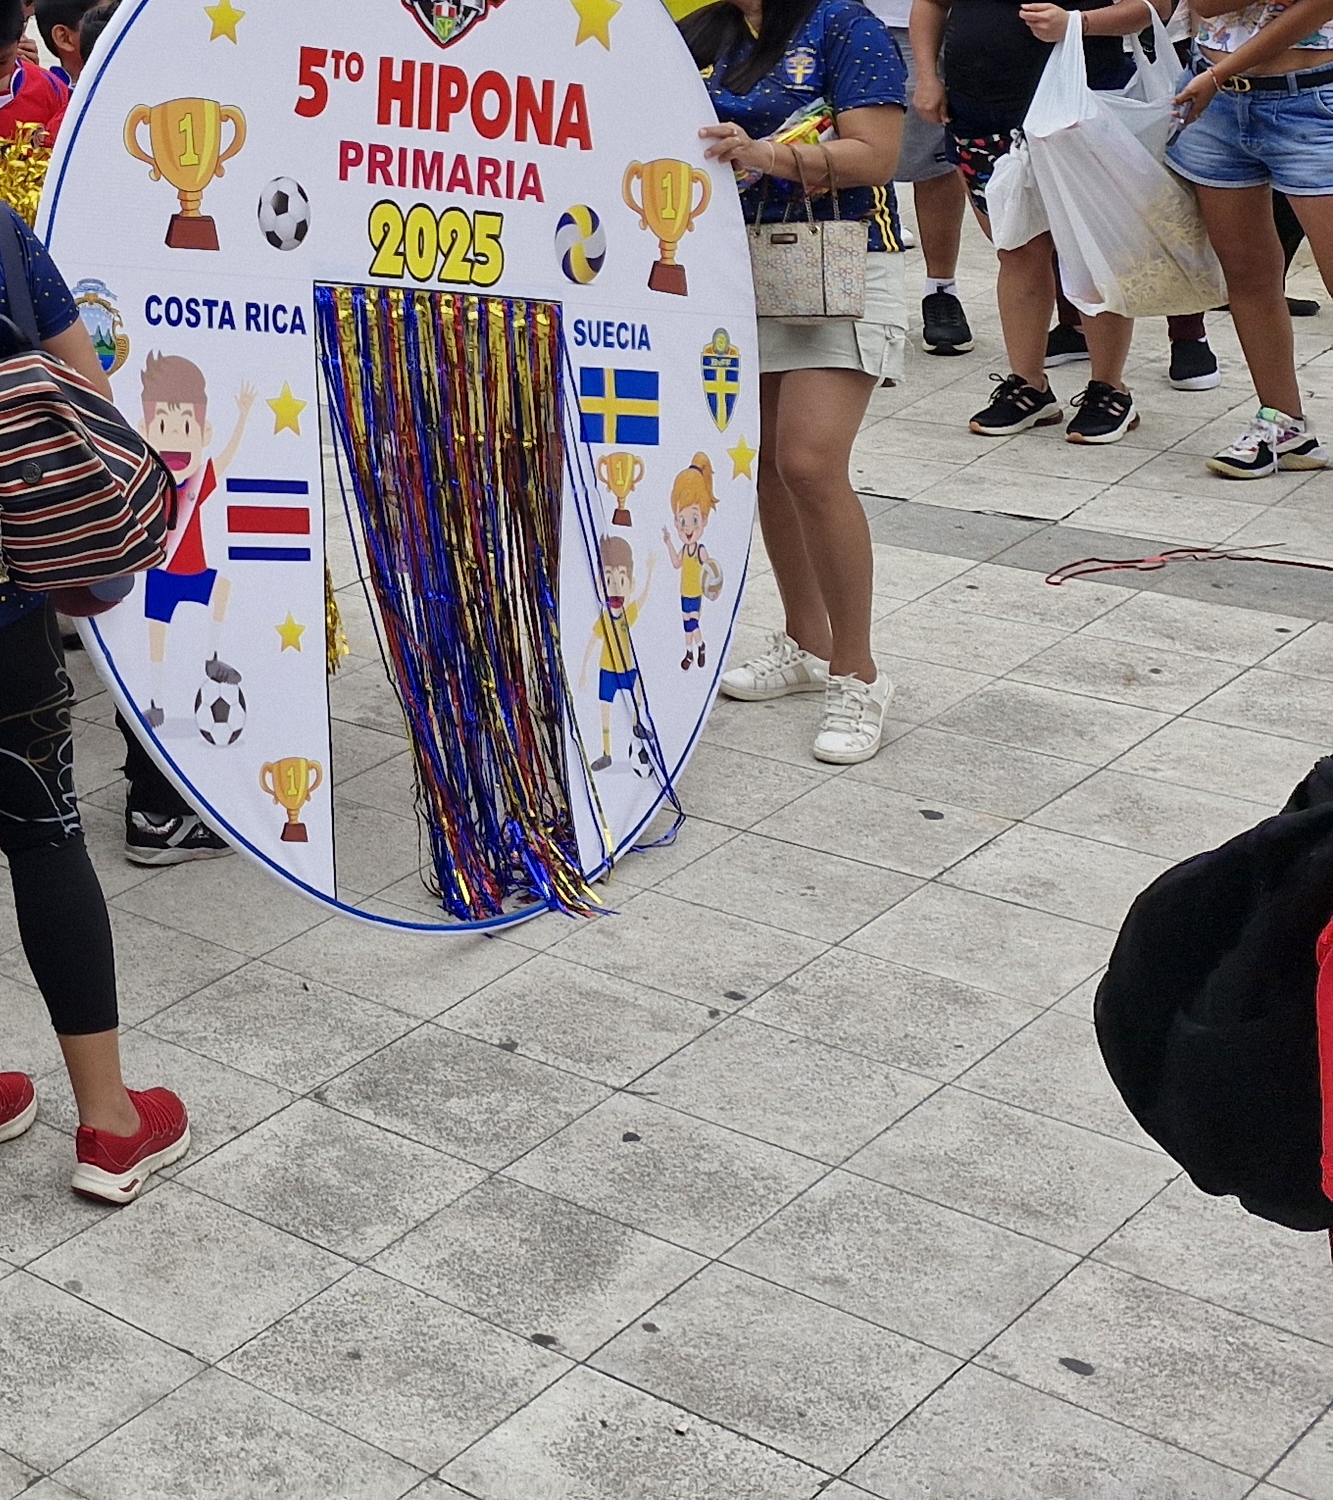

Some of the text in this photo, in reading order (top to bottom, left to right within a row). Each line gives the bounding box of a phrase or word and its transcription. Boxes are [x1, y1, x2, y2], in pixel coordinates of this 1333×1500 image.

[377, 56, 593, 151] HIPONA
[338, 139, 546, 203] PRIMARIA
[368, 199, 505, 288] 2025
[144, 294, 308, 336] COSTA RICA
[573, 318, 652, 351] SUECIA
